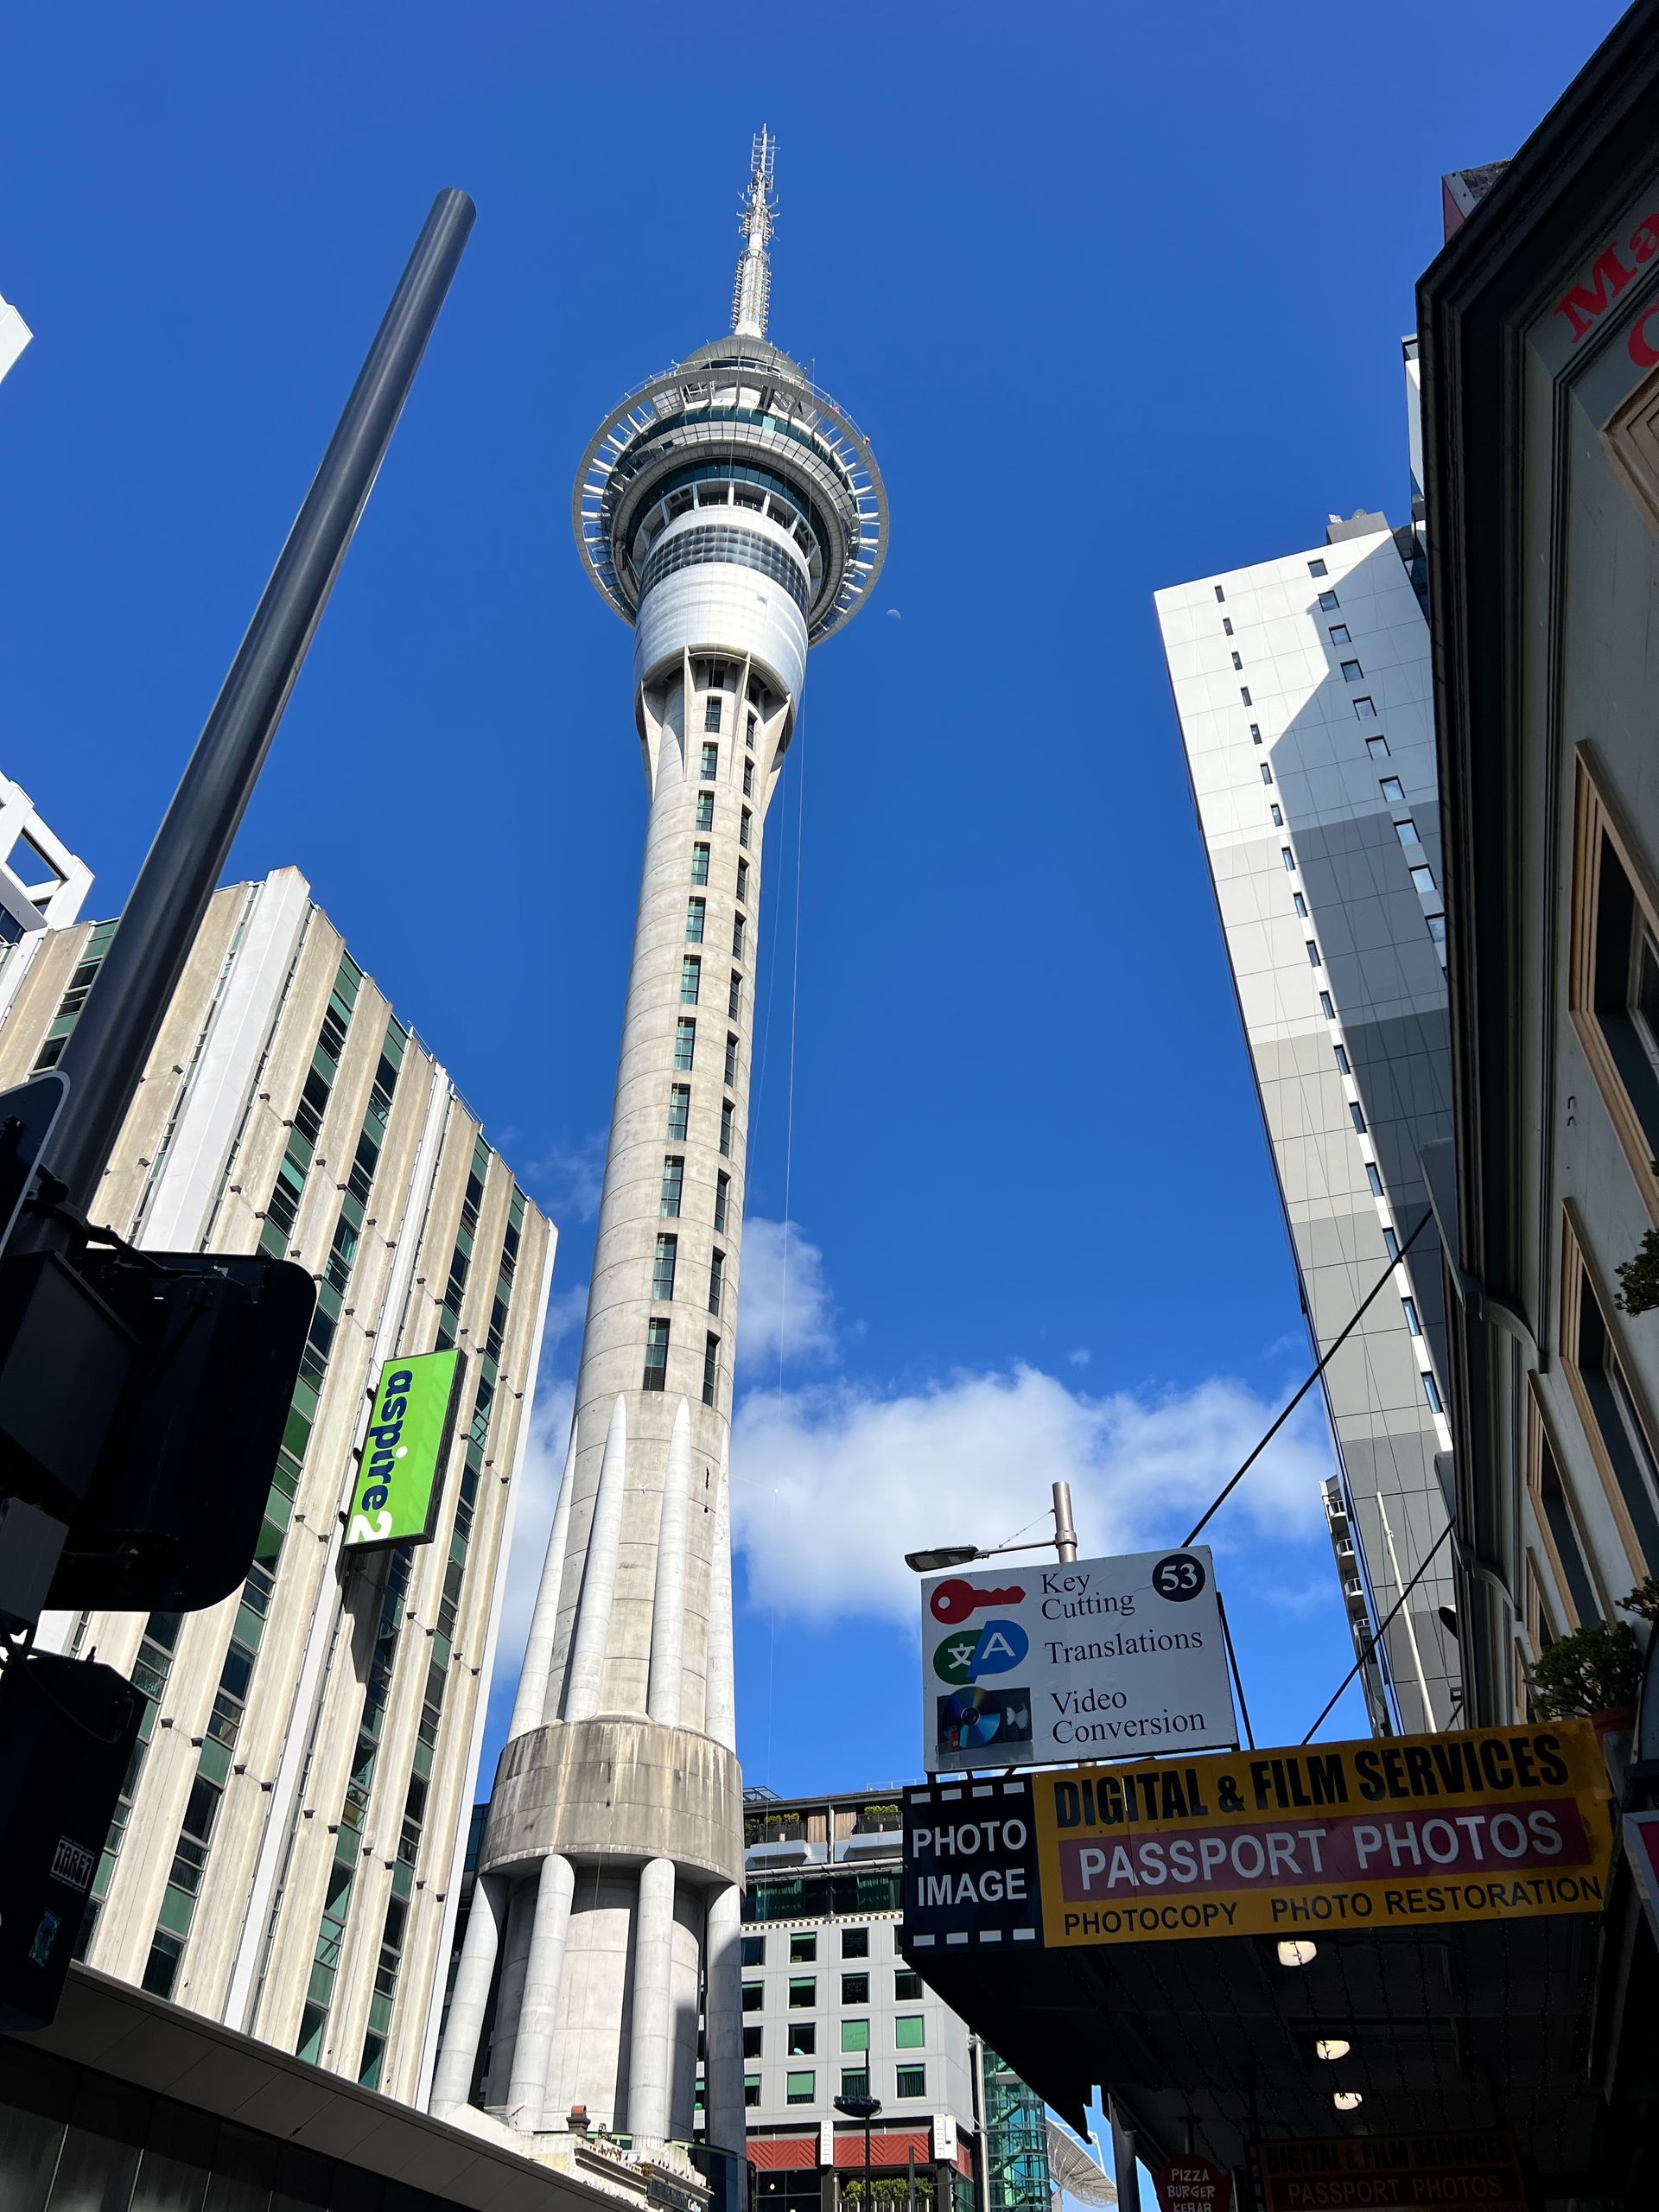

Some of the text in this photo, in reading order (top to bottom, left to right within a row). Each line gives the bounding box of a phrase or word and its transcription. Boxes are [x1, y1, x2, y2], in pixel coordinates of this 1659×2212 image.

[1041, 1573, 1090, 1595] Key
[1161, 1563, 1198, 1591] 53
[1041, 1592, 1135, 1620] Cutting
[1045, 1629, 1203, 1664] Translations
[1051, 1688, 1127, 1715] Video
[1052, 1709, 1206, 1744] Conversion
[1054, 1734, 1568, 1828] DIGITAL & FILM SERVICES
[912, 1819, 1027, 1858] PHOTO
[1079, 1810, 1563, 1891] PASSPORT PHOTOS
[918, 1868, 1027, 1906] IMAGE
[1065, 1876, 1603, 1936] PHOTOCOPY PHOTO RESTORATION
[1268, 2143, 1337, 2172] DIGITAL
[1362, 2139, 1409, 2168] FILM
[1410, 2134, 1514, 2166] SERVICES
[1166, 2185, 1216, 2200] BURGER
[1171, 2168, 1209, 2182] PIZZA
[1288, 2174, 1503, 2205] PASSPORT PHOTOS
